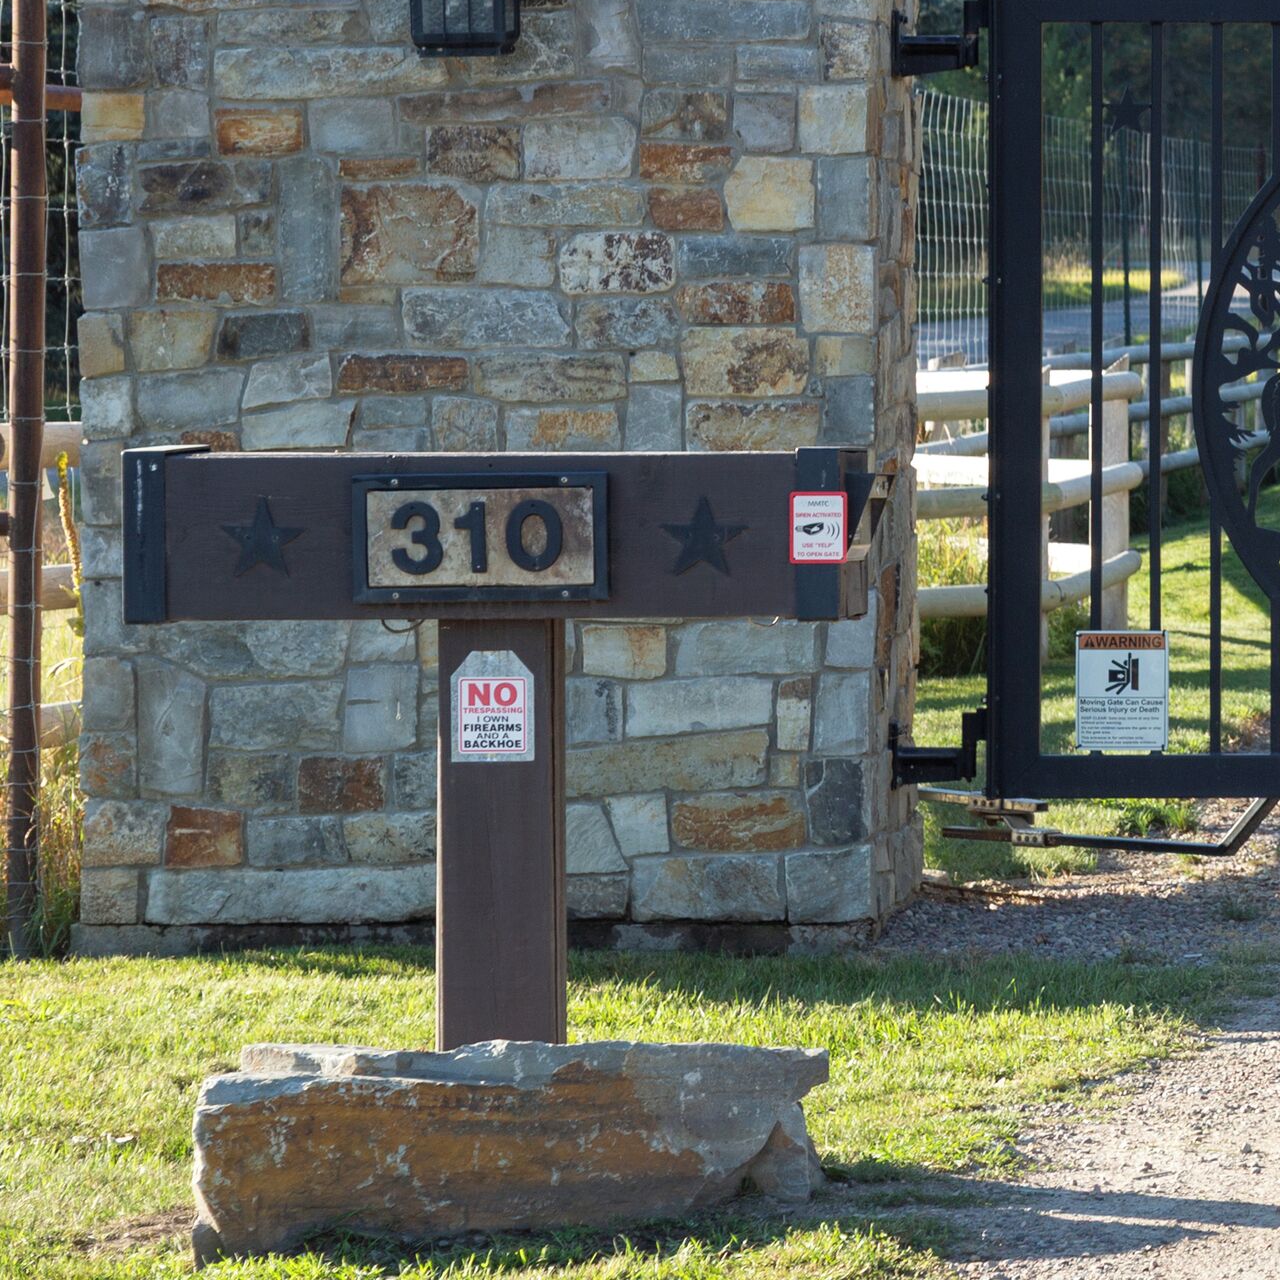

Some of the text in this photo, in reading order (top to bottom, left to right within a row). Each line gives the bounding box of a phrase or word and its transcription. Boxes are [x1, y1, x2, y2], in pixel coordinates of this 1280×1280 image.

[390, 500, 564, 575] 310
[1095, 636, 1162, 648] WARNING
[468, 682, 518, 707] NO
[1080, 699, 1106, 707] Moving
[1108, 706, 1128, 714] Injury
[463, 723, 522, 732] FIREARMS
[464, 740, 522, 748] BACKHOE
